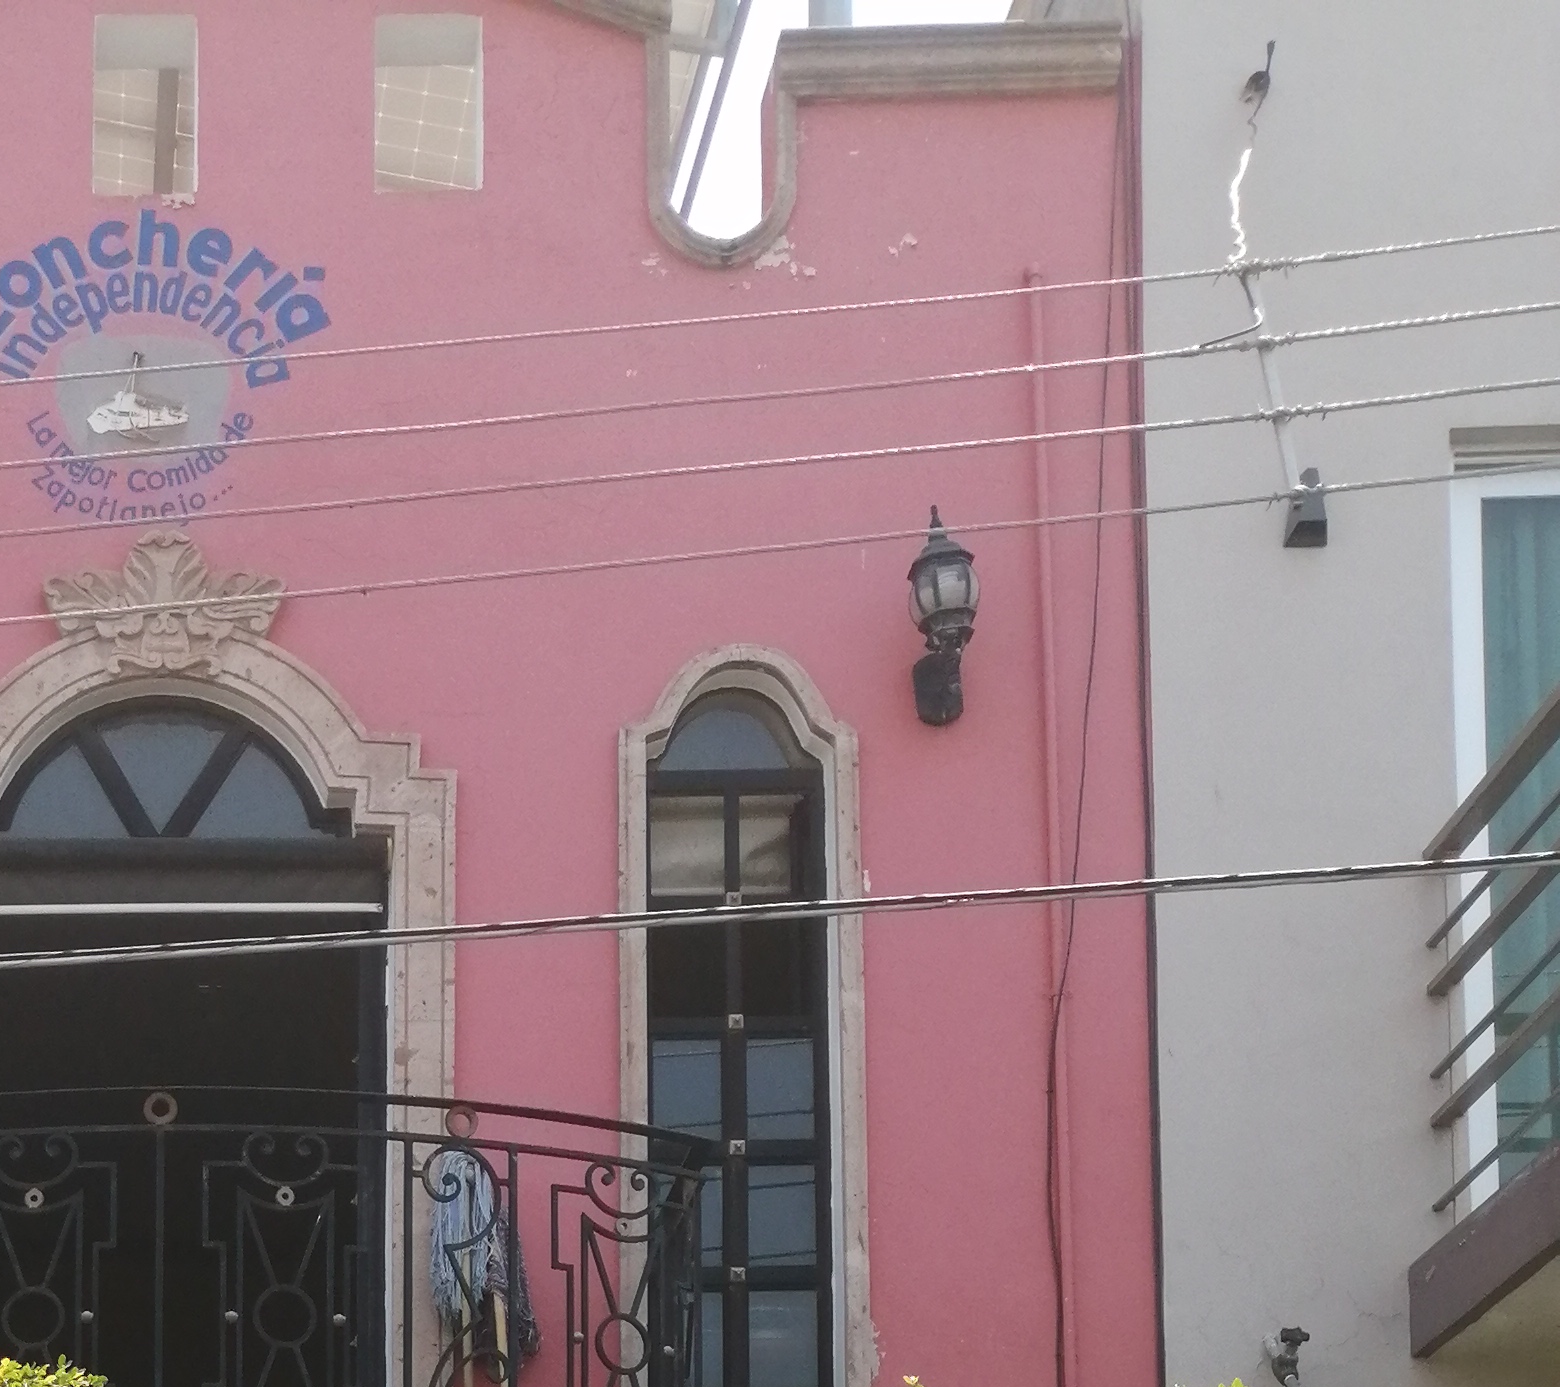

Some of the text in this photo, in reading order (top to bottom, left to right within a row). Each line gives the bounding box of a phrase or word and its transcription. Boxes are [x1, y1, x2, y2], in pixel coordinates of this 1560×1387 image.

[26, 411, 57, 448] La
[127, 445, 230, 493] Comida
[220, 411, 254, 443] de
